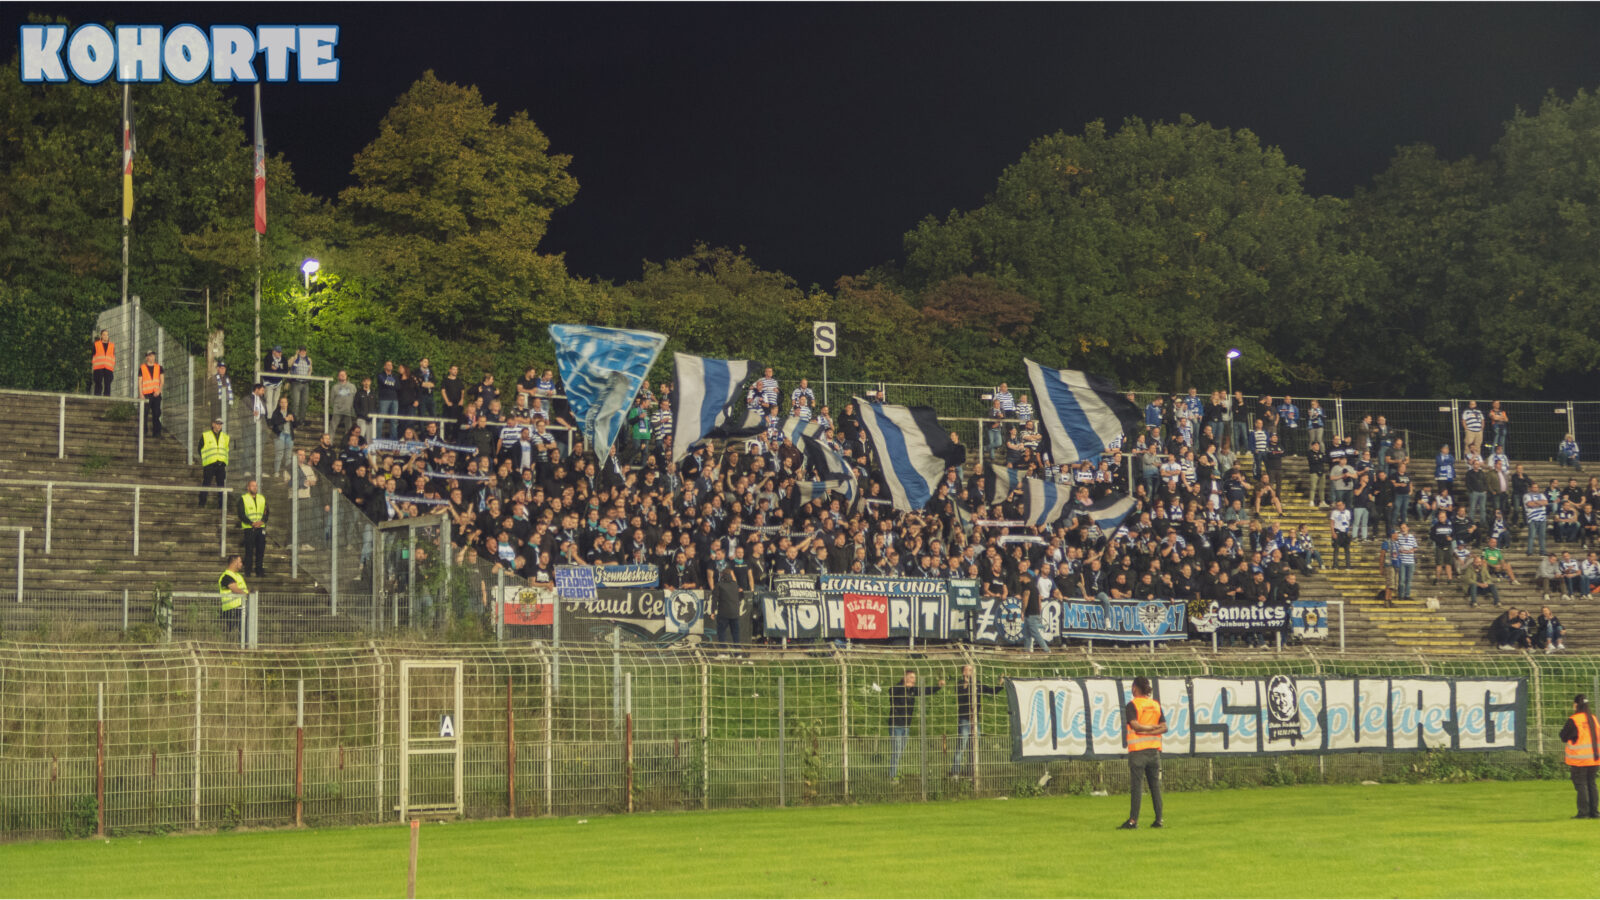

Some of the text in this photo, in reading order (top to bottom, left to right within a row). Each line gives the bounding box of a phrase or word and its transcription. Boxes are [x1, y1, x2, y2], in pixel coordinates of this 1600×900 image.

[816, 326, 834, 353] S
[555, 567, 592, 578] SEKTION
[595, 566, 658, 583] Freundeskreis
[556, 577, 594, 588] STADION
[557, 587, 596, 599] VERBOT
[764, 597, 967, 631] KOHRTE
[846, 599, 887, 613] ULTRAS
[856, 613, 876, 630] MZ
[1166, 603, 1186, 632] 47
[1267, 619, 1285, 627] 1997
[440, 715, 455, 737] A
